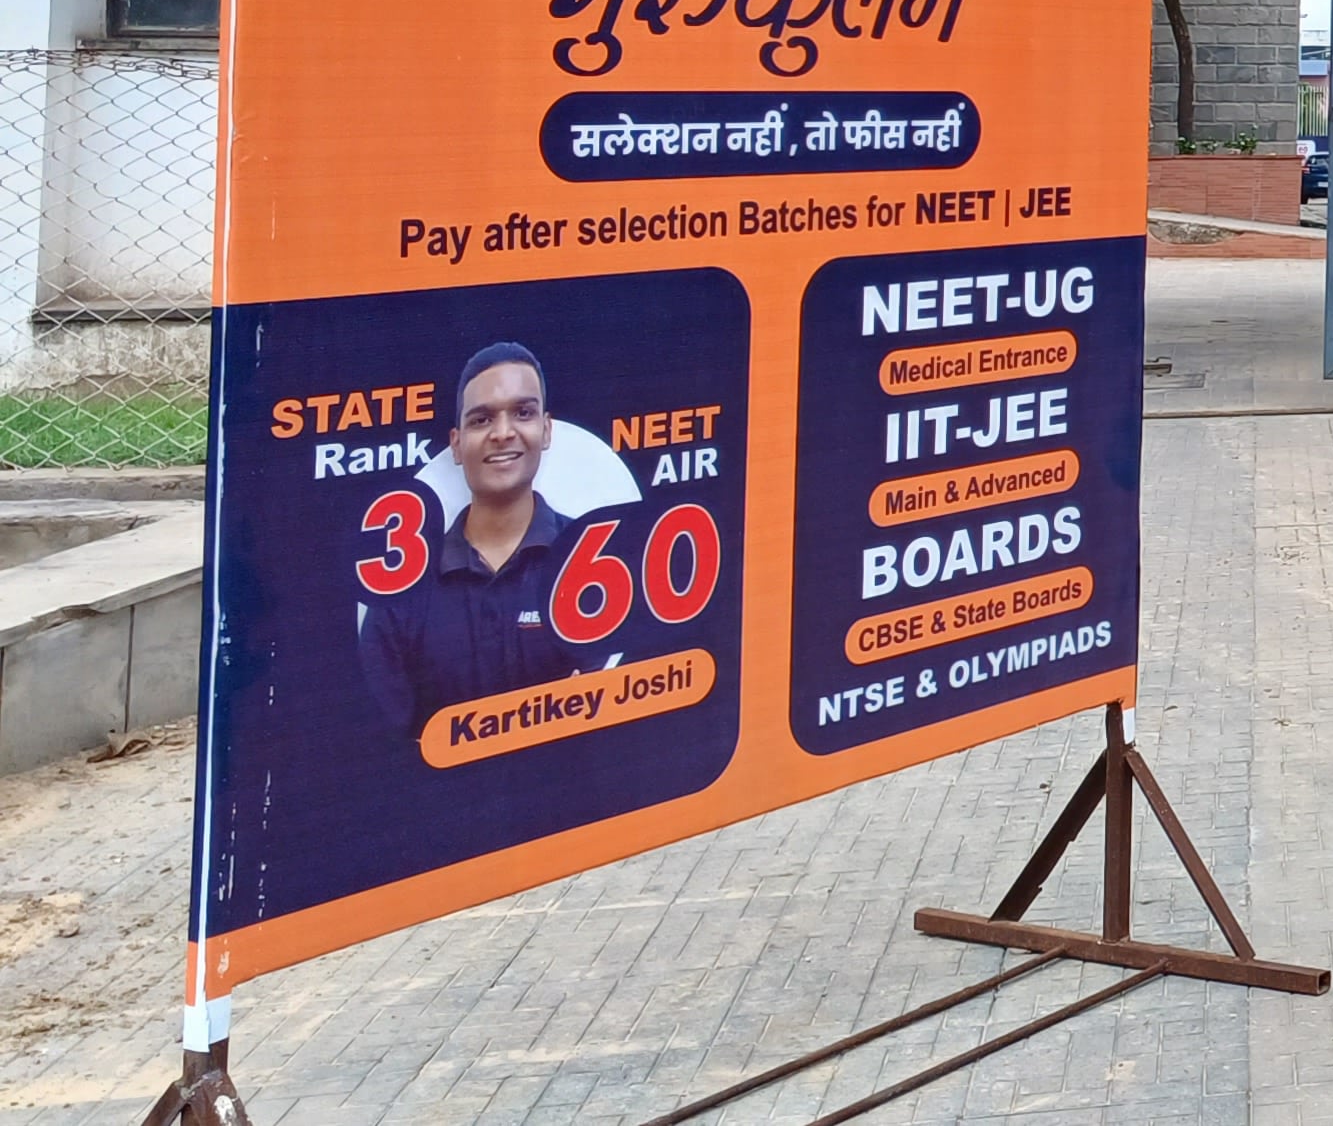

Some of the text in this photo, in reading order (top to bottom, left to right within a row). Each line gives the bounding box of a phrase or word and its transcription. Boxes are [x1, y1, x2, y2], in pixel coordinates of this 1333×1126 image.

[571, 114, 720, 157] सलेक्शन
[805, 112, 838, 150] तो
[843, 110, 907, 149] फीस
[912, 103, 964, 151] नहीं
[401, 220, 471, 264] Pay
[484, 213, 567, 251] after
[578, 205, 726, 245] selection
[740, 199, 856, 234] Batches
[867, 196, 905, 226] for
[917, 191, 995, 224] NEET
[1020, 187, 1070, 218] JEE
[863, 267, 1093, 335] NEET-UG
[890, 347, 1066, 384] Medical Entrance
[272, 384, 434, 437] STATE
[613, 406, 720, 451] NEET
[886, 389, 1067, 463] IIT-JEE
[315, 433, 434, 480] Rank
[652, 448, 717, 486] AIR
[886, 461, 1064, 514] Main & Advanced
[356, 490, 429, 595] 3
[549, 503, 721, 644] 60
[863, 507, 1080, 599] BOARDS
[860, 580, 1081, 651] CBSE & State Boards
[450, 665, 691, 746] Kartikey Joshi
[819, 622, 1110, 725] NTSE & OLYMPIADS
